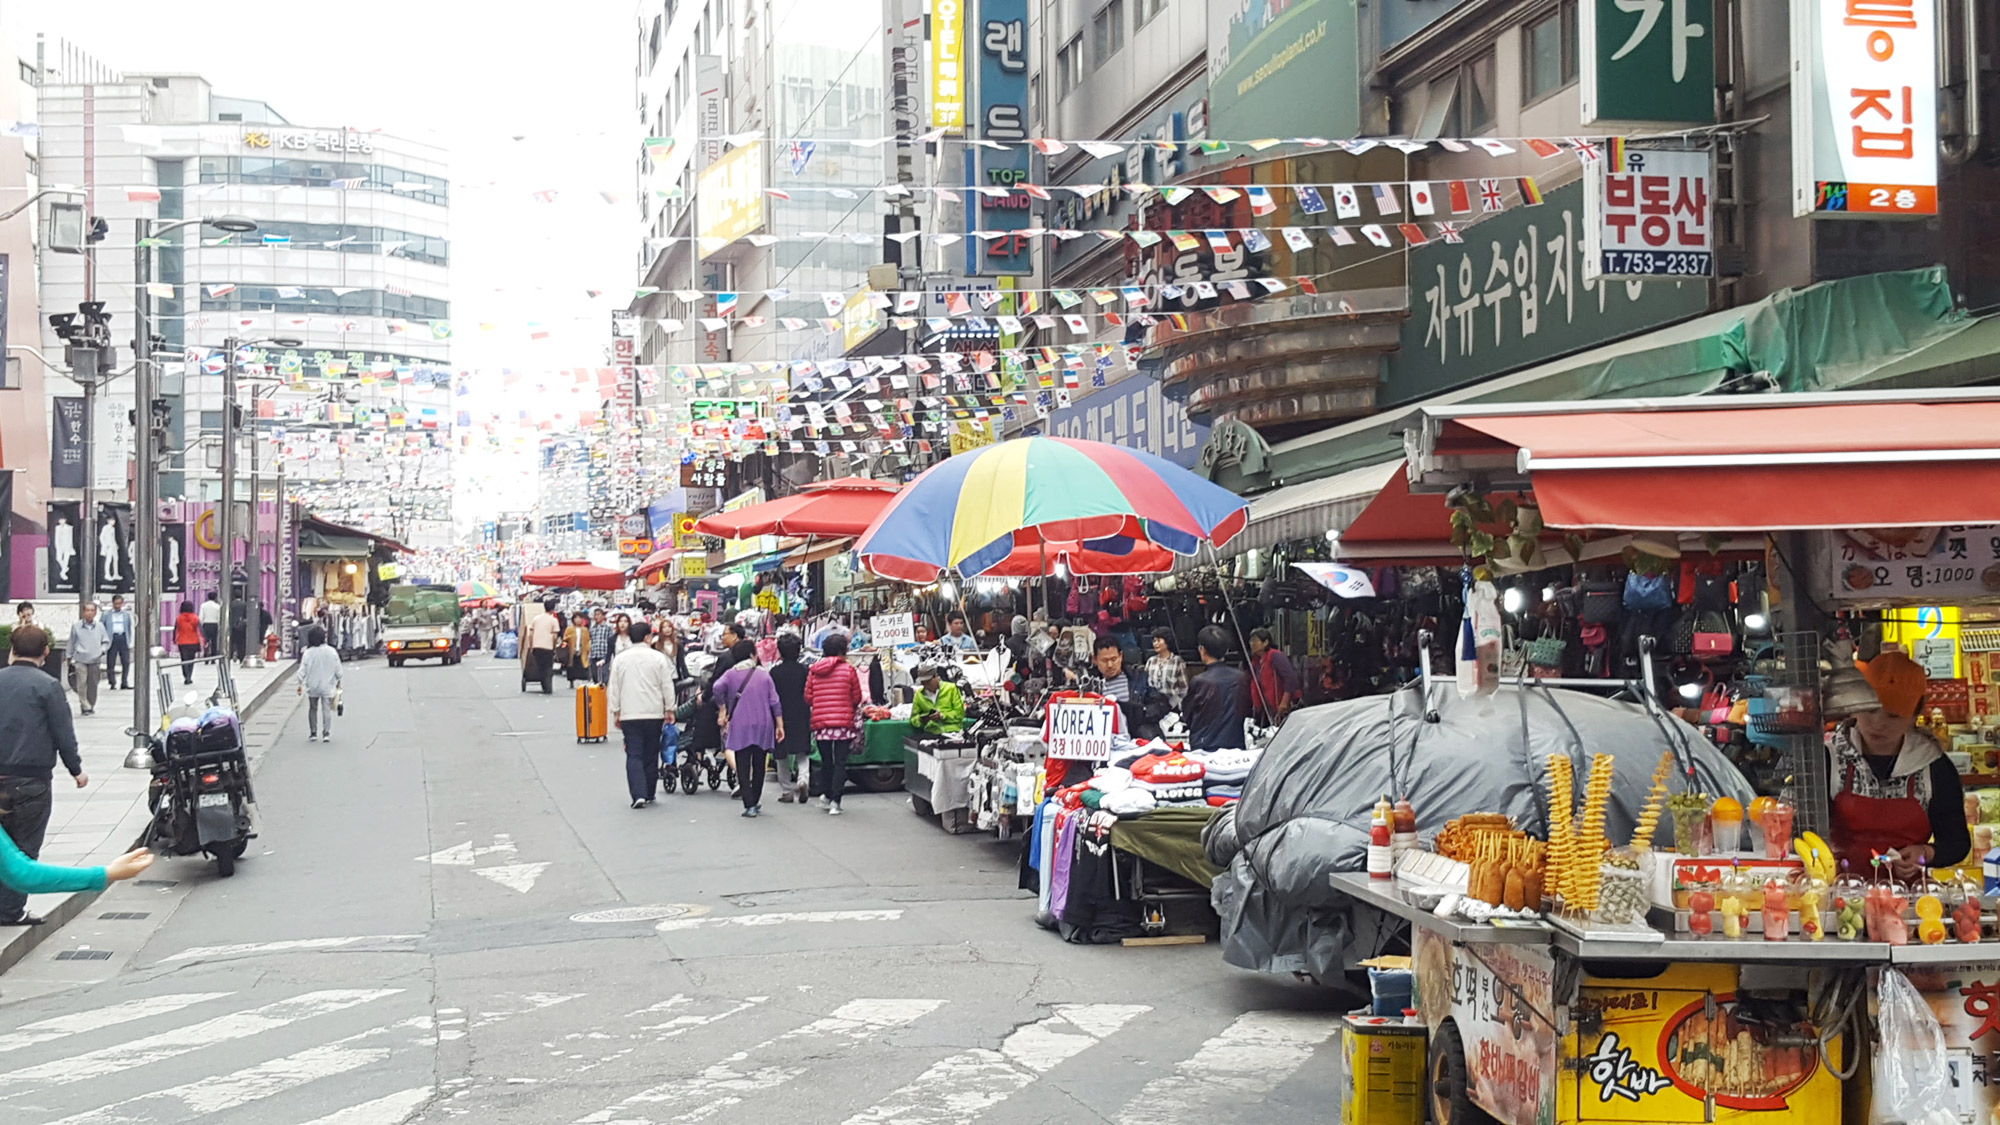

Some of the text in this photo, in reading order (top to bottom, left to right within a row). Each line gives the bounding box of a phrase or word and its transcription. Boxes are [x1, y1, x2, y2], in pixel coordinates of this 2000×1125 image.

[280, 135, 308, 150] KB
[315, 135, 373, 154] 국민은행
[989, 168, 1026, 183] TOP
[982, 193, 1031, 209] LAND
[1606, 175, 1707, 247] 부동산
[988, 234, 1028, 256] 2F
[1605, 252, 1709, 275] T.753-2337
[880, 617, 904, 627] 스카프
[876, 627, 910, 640] 2,000원
[1053, 709, 1110, 736] KOREA T
[1053, 737, 1066, 756] 3장
[1153, 761, 1201, 776] Korea
[1155, 787, 1203, 799] Korea
